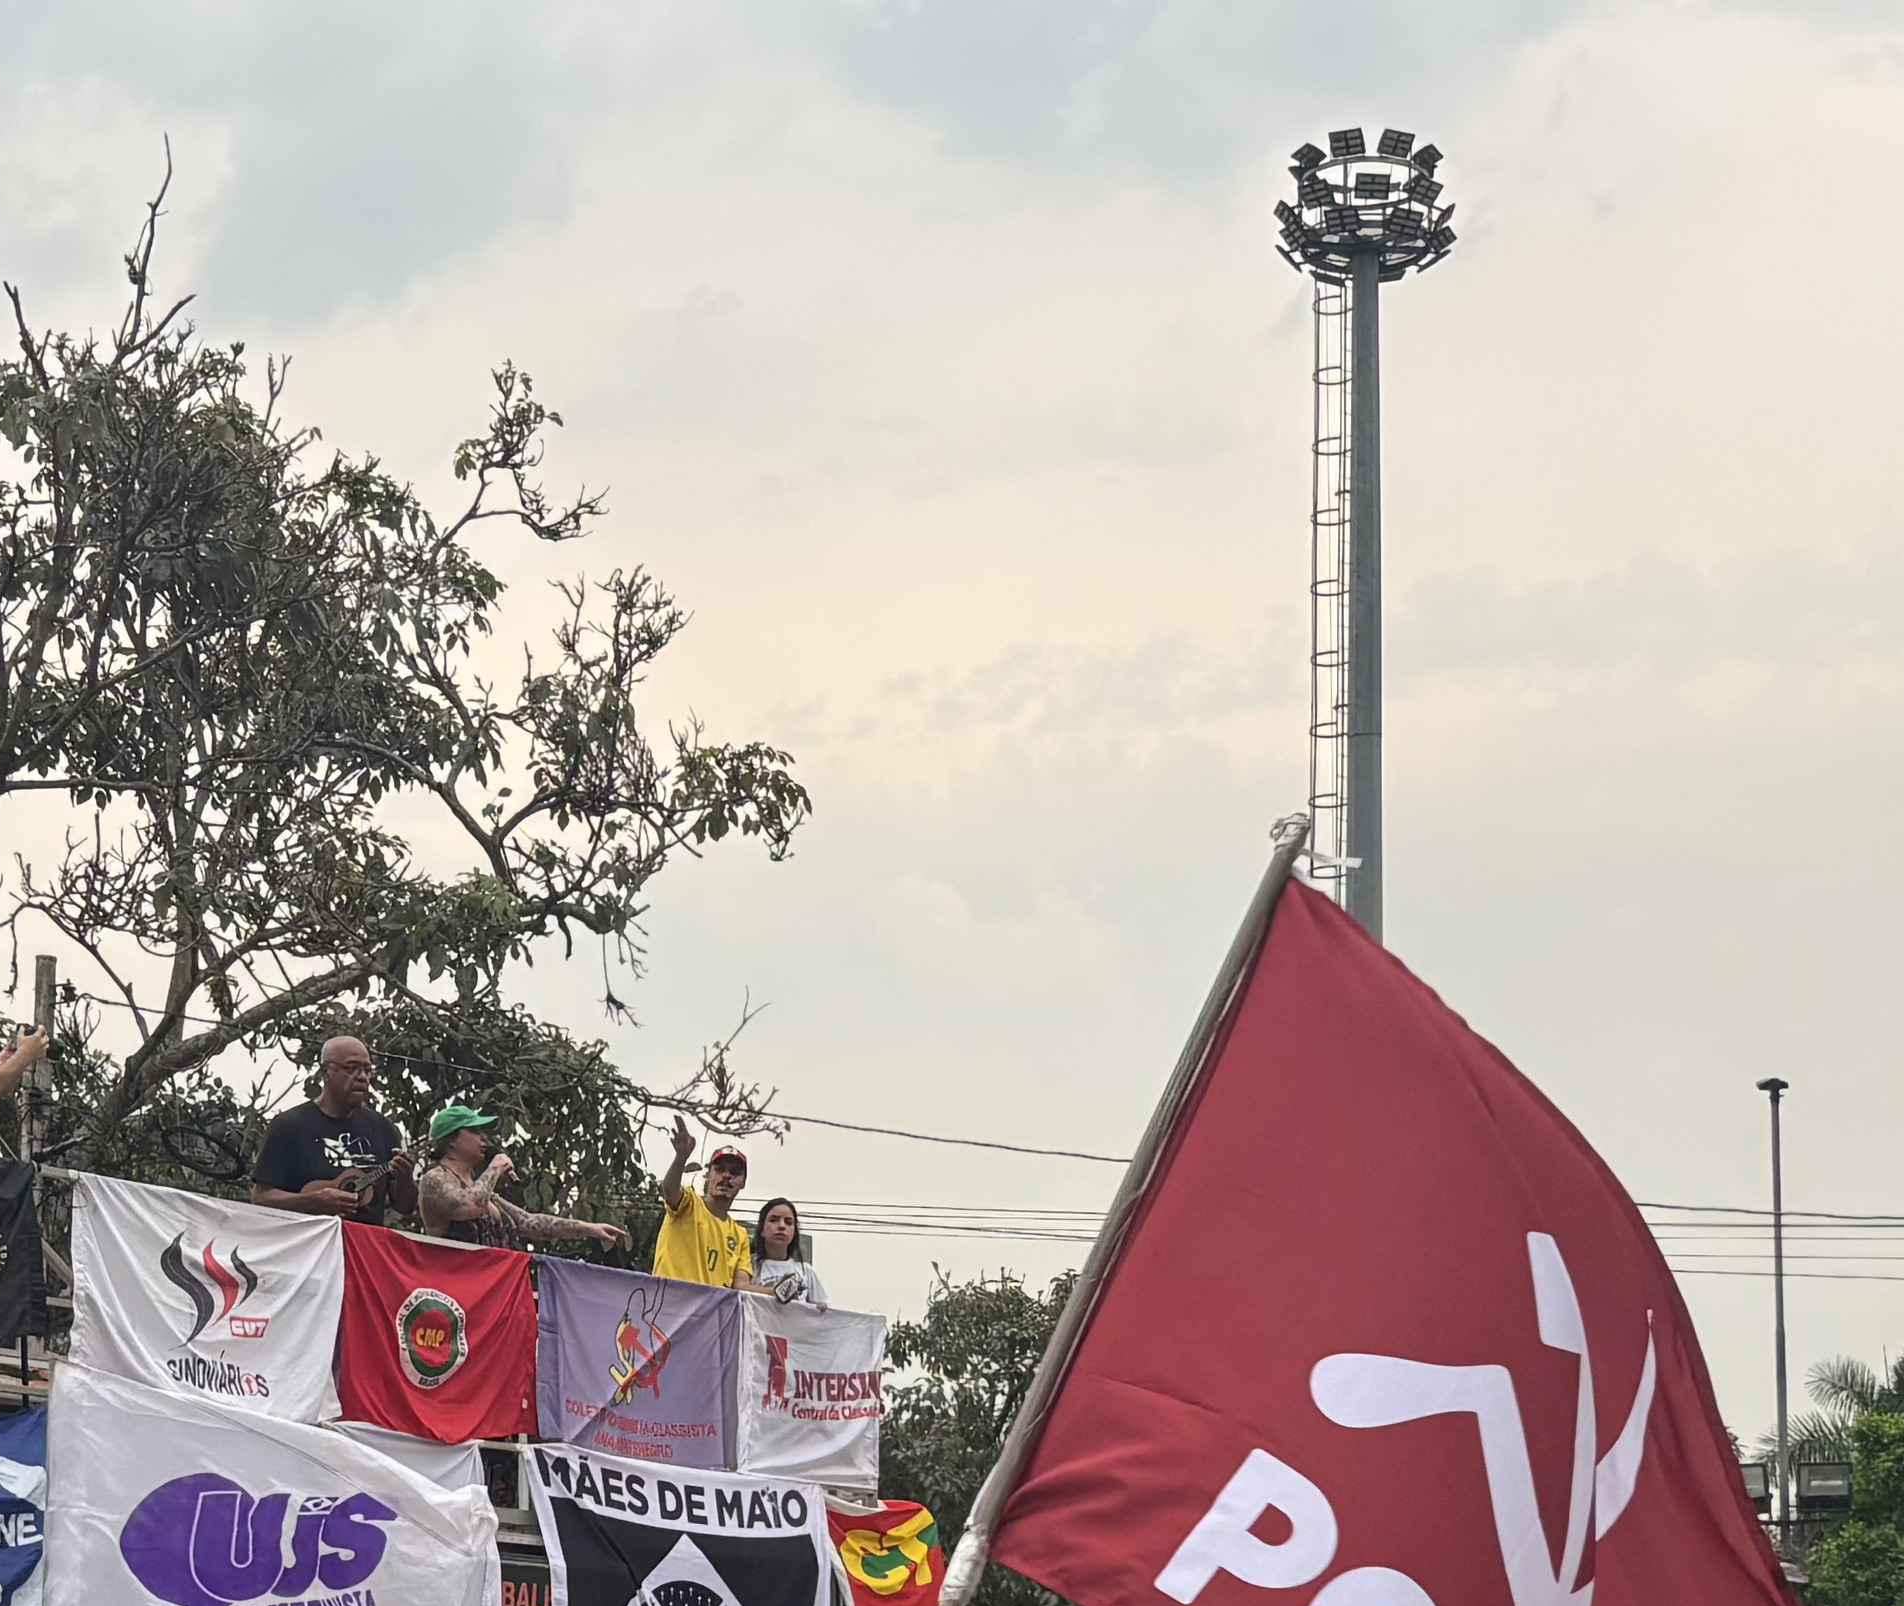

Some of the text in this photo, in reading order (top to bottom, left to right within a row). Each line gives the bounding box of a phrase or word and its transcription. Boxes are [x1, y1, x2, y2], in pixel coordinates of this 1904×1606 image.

[231, 1319, 269, 1338] CUT
[415, 1327, 446, 1348] CMP
[532, 1447, 808, 1529] MÃES DE MAIO
